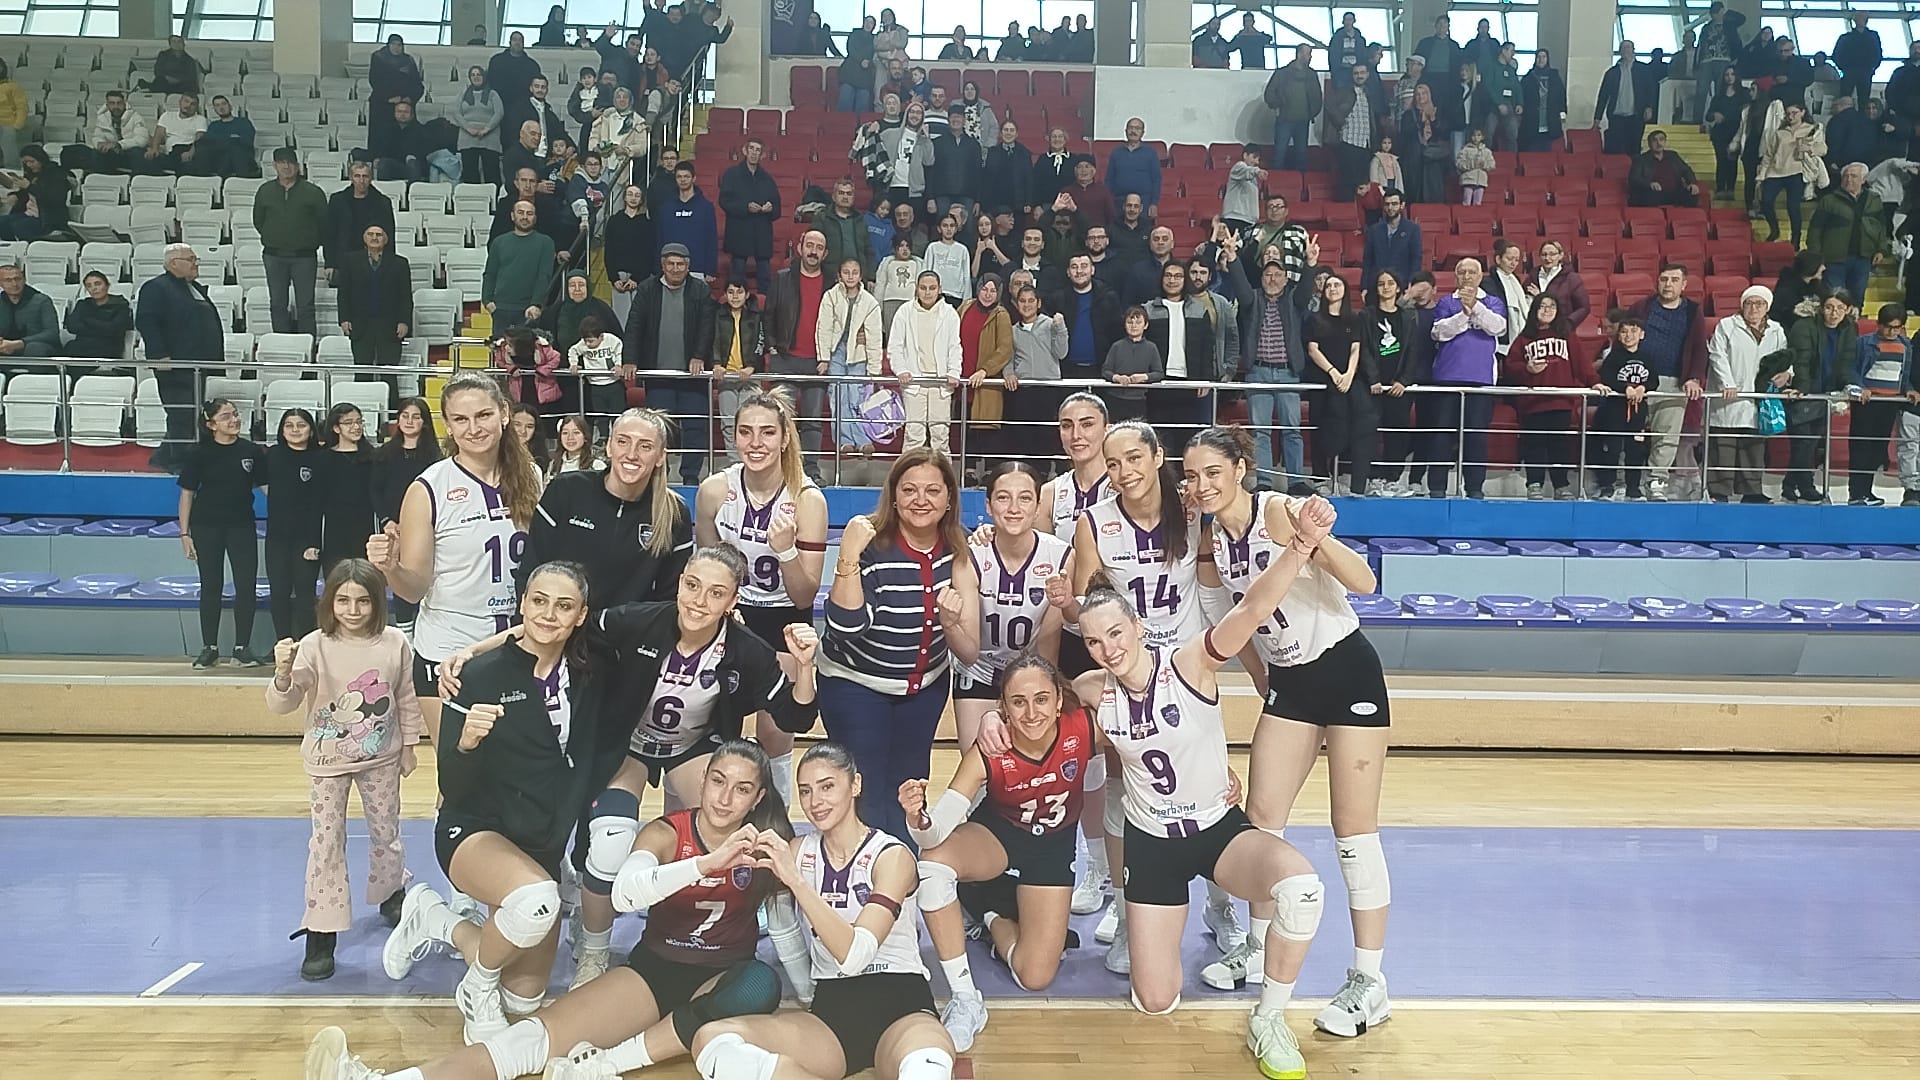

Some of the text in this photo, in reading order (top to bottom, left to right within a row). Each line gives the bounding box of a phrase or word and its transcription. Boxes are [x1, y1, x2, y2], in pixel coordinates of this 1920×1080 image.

[1128, 574, 1182, 619] 14
[986, 612, 1034, 651] 10
[651, 695, 685, 730] 6
[1141, 749, 1177, 796] 9
[1019, 790, 1070, 828] 13
[688, 900, 726, 937] 7
